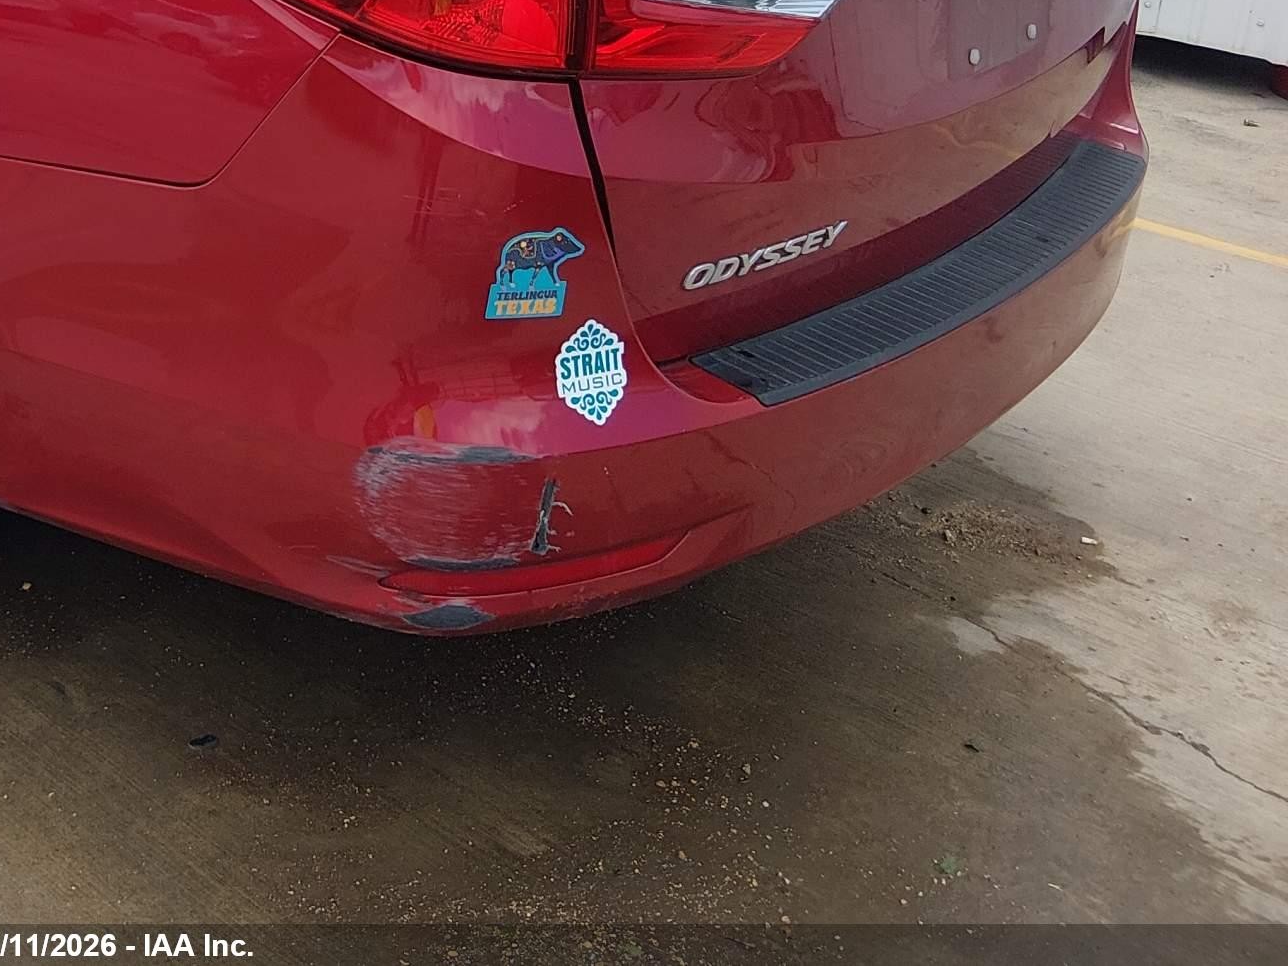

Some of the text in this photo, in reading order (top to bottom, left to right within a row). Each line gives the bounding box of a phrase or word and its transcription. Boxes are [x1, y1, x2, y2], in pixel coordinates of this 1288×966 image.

[683, 220, 848, 290] ODYSSEY
[495, 289, 558, 301] TERLINGUA
[494, 299, 558, 315] TEXAS
[559, 348, 620, 380] STRAIT
[562, 372, 623, 394] MUSIC
